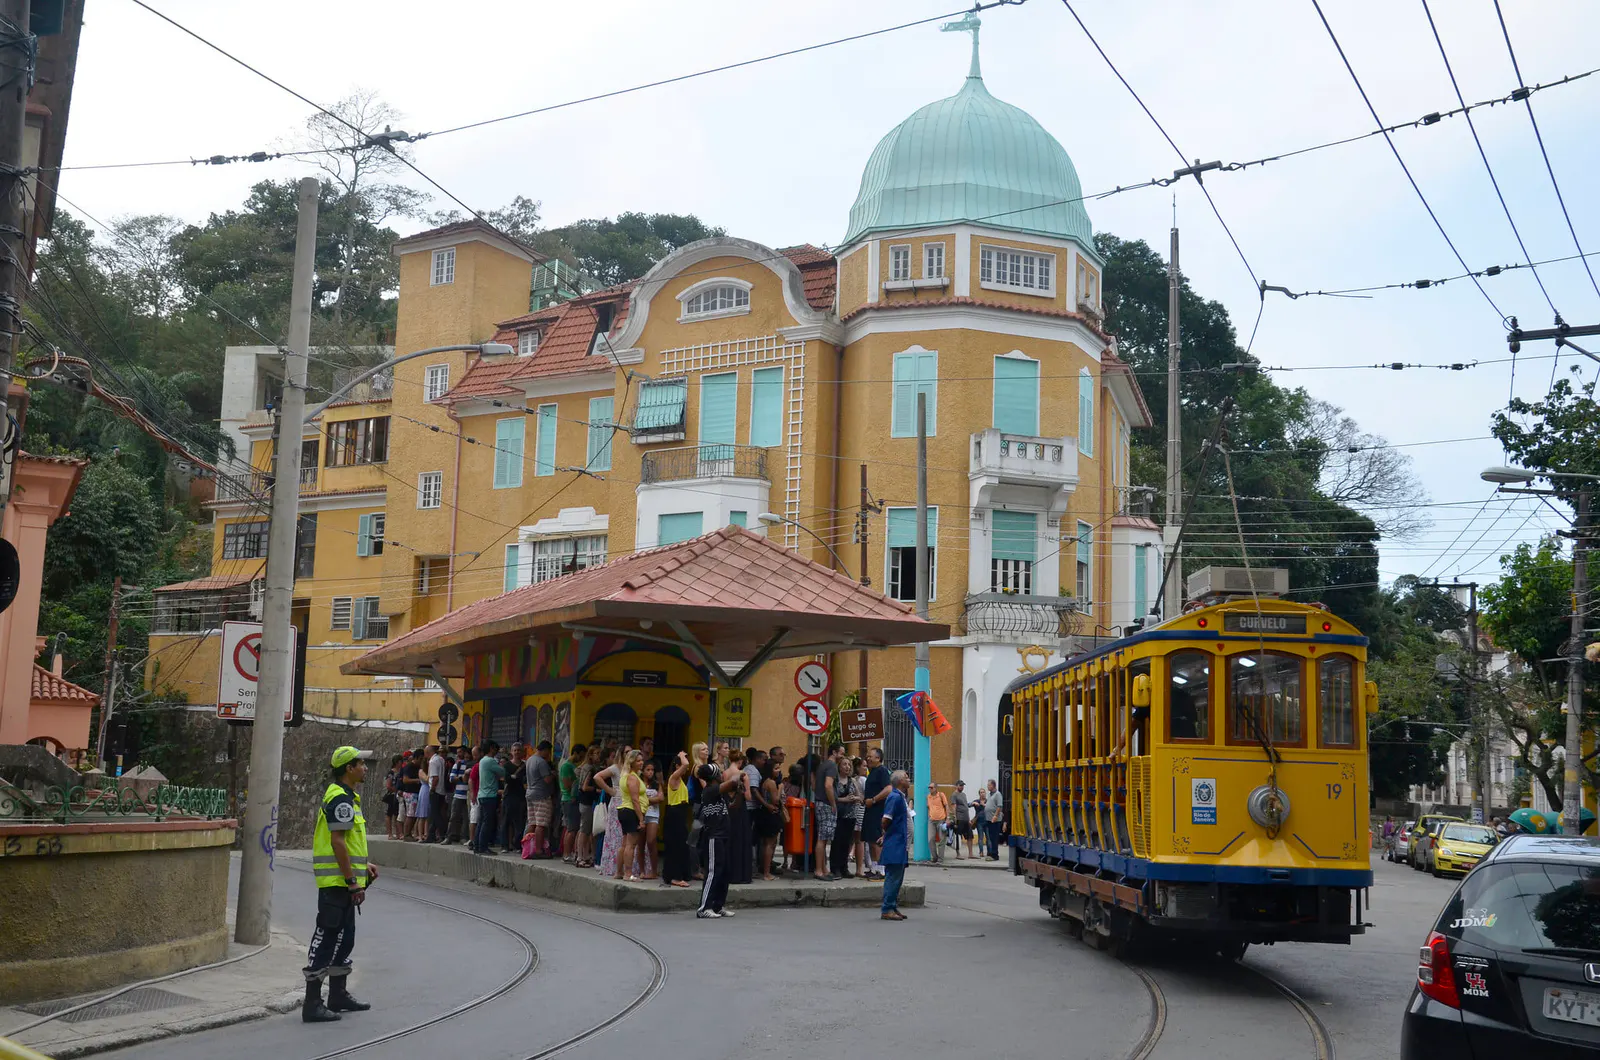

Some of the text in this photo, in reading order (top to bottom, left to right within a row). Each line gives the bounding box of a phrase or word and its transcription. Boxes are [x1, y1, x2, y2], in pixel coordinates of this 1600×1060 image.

[1240, 616, 1287, 629] CURVELO
[238, 688, 256, 697] Sen
[236, 701, 255, 710] Proi
[848, 722, 877, 733] Largo do
[850, 731, 876, 740] Curvelo
[1325, 783, 1342, 800] 19
[1449, 918, 1487, 929] JDM
[1463, 987, 1489, 997] MOM
